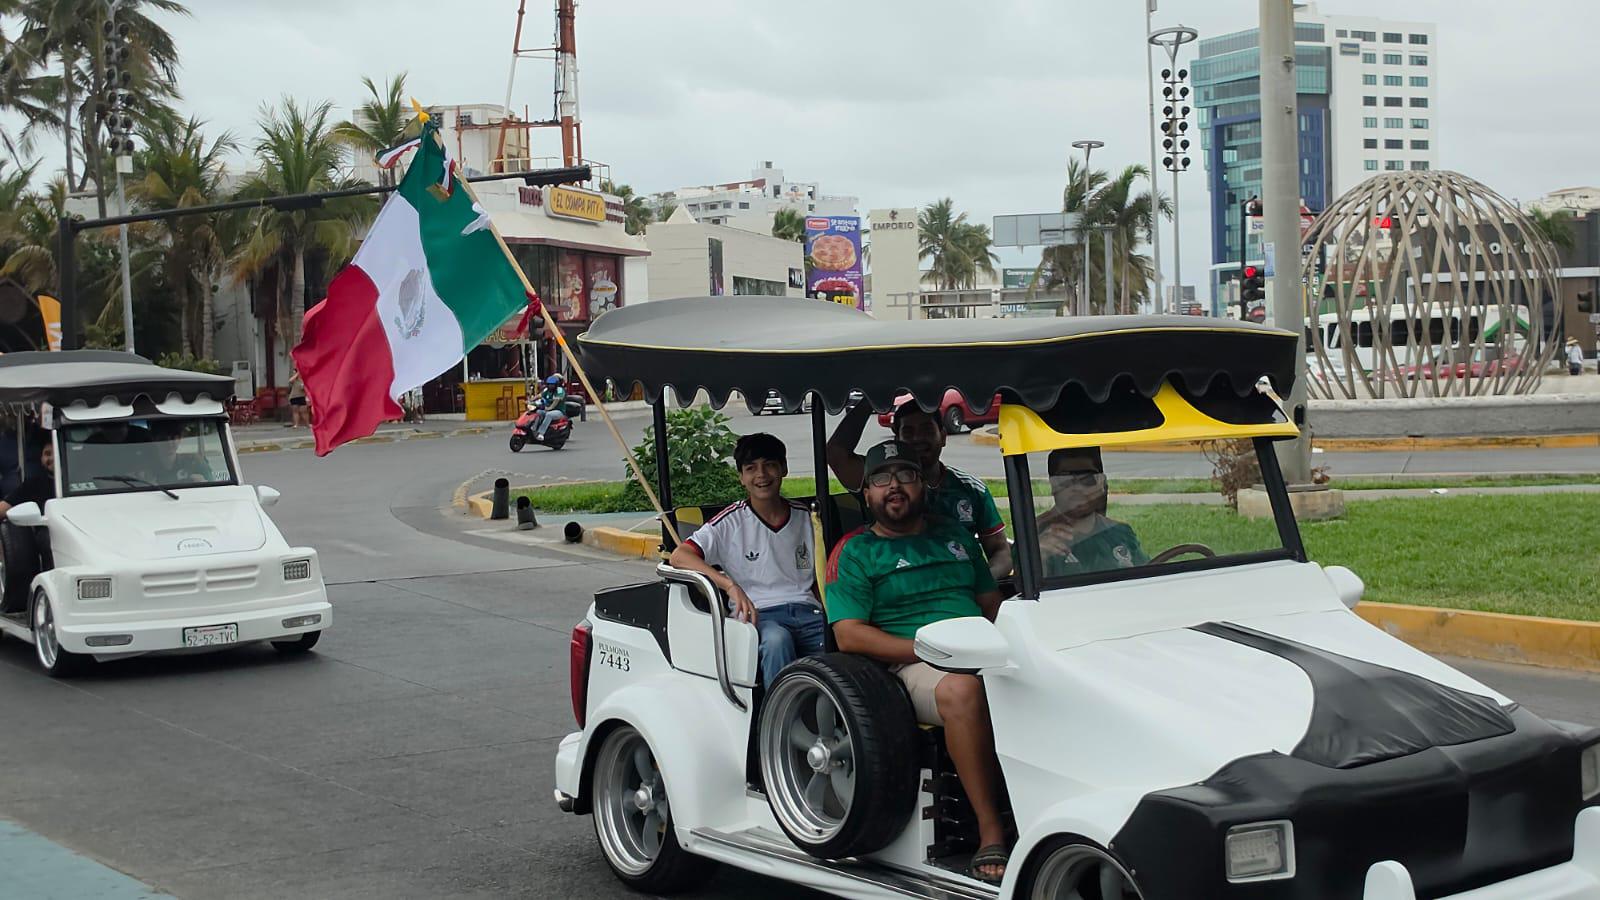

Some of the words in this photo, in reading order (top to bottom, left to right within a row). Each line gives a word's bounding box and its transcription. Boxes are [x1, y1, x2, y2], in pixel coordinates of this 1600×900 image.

[519, 186, 544, 208] TACOS
[556, 192, 564, 209] EL
[566, 194, 586, 213] COMPA
[872, 221, 914, 231] EMPORIO
[1001, 304, 1027, 313] HOTEL
[187, 631, 235, 647] 52-52-TVC
[600, 650, 631, 672] 7443
